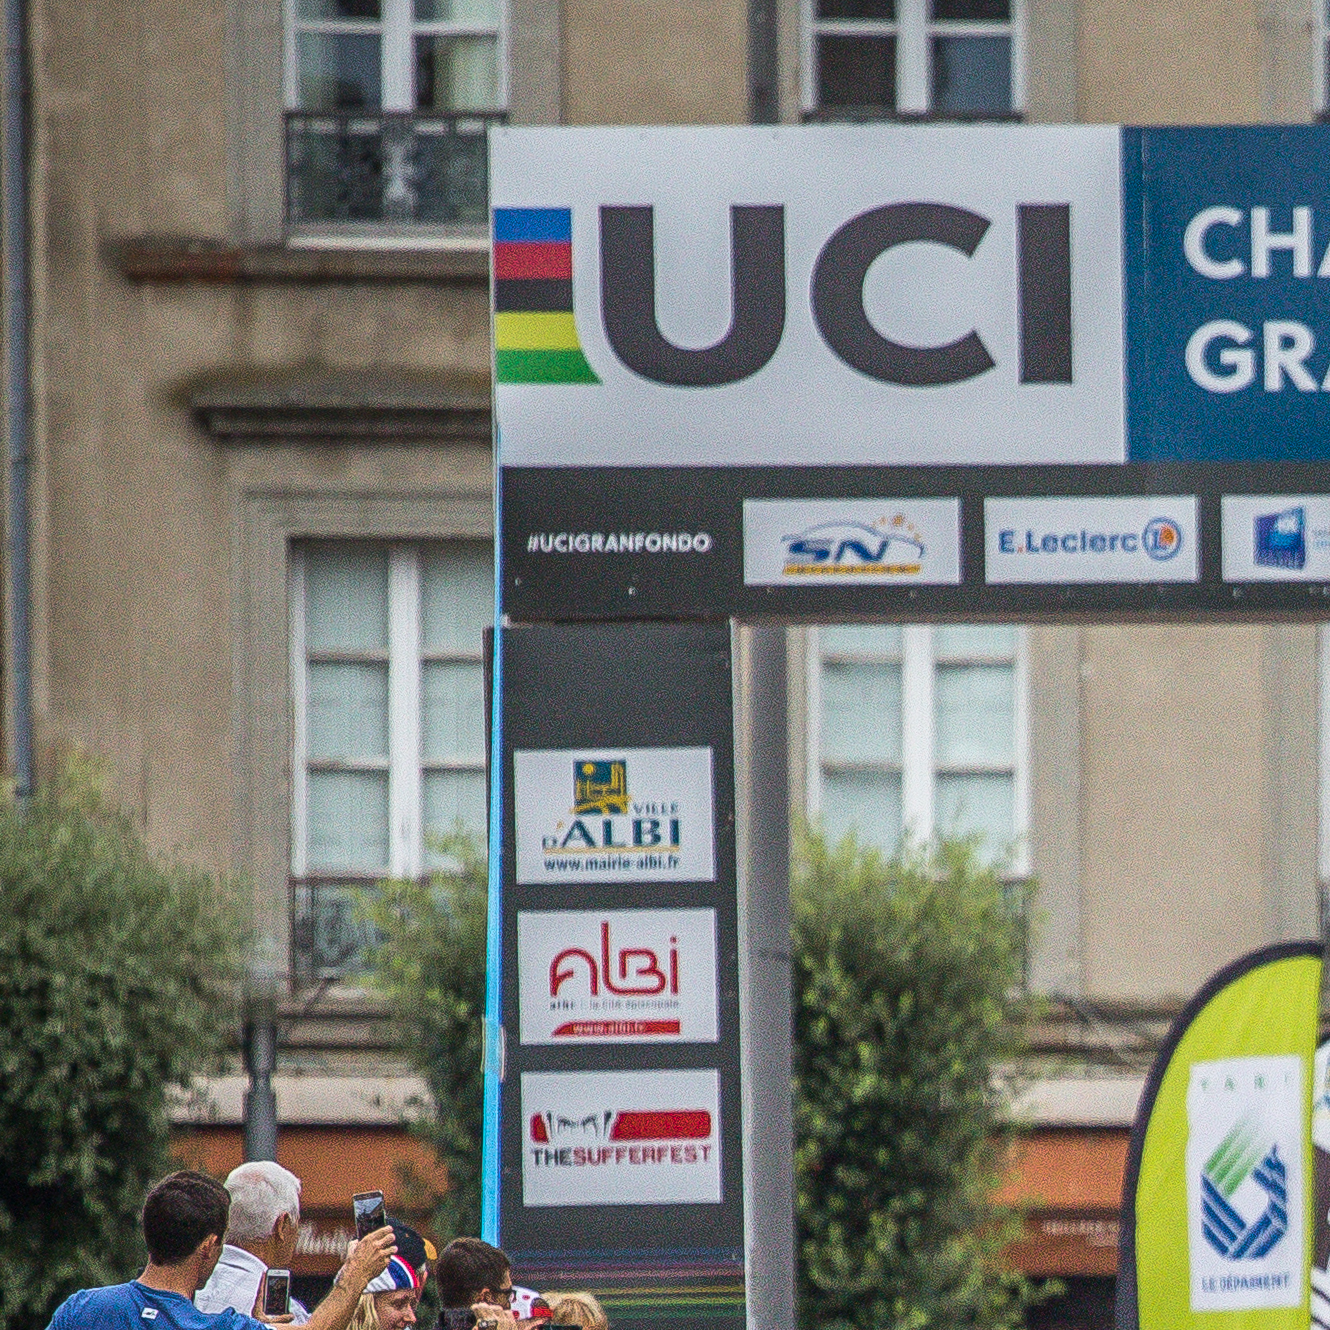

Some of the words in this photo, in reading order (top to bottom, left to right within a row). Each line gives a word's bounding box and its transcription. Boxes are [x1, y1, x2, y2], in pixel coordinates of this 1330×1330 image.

[600, 202, 1073, 388] UCI
[526, 531, 711, 554] #UCIGRANFONDO
[998, 530, 1138, 555] E.Leclerc
